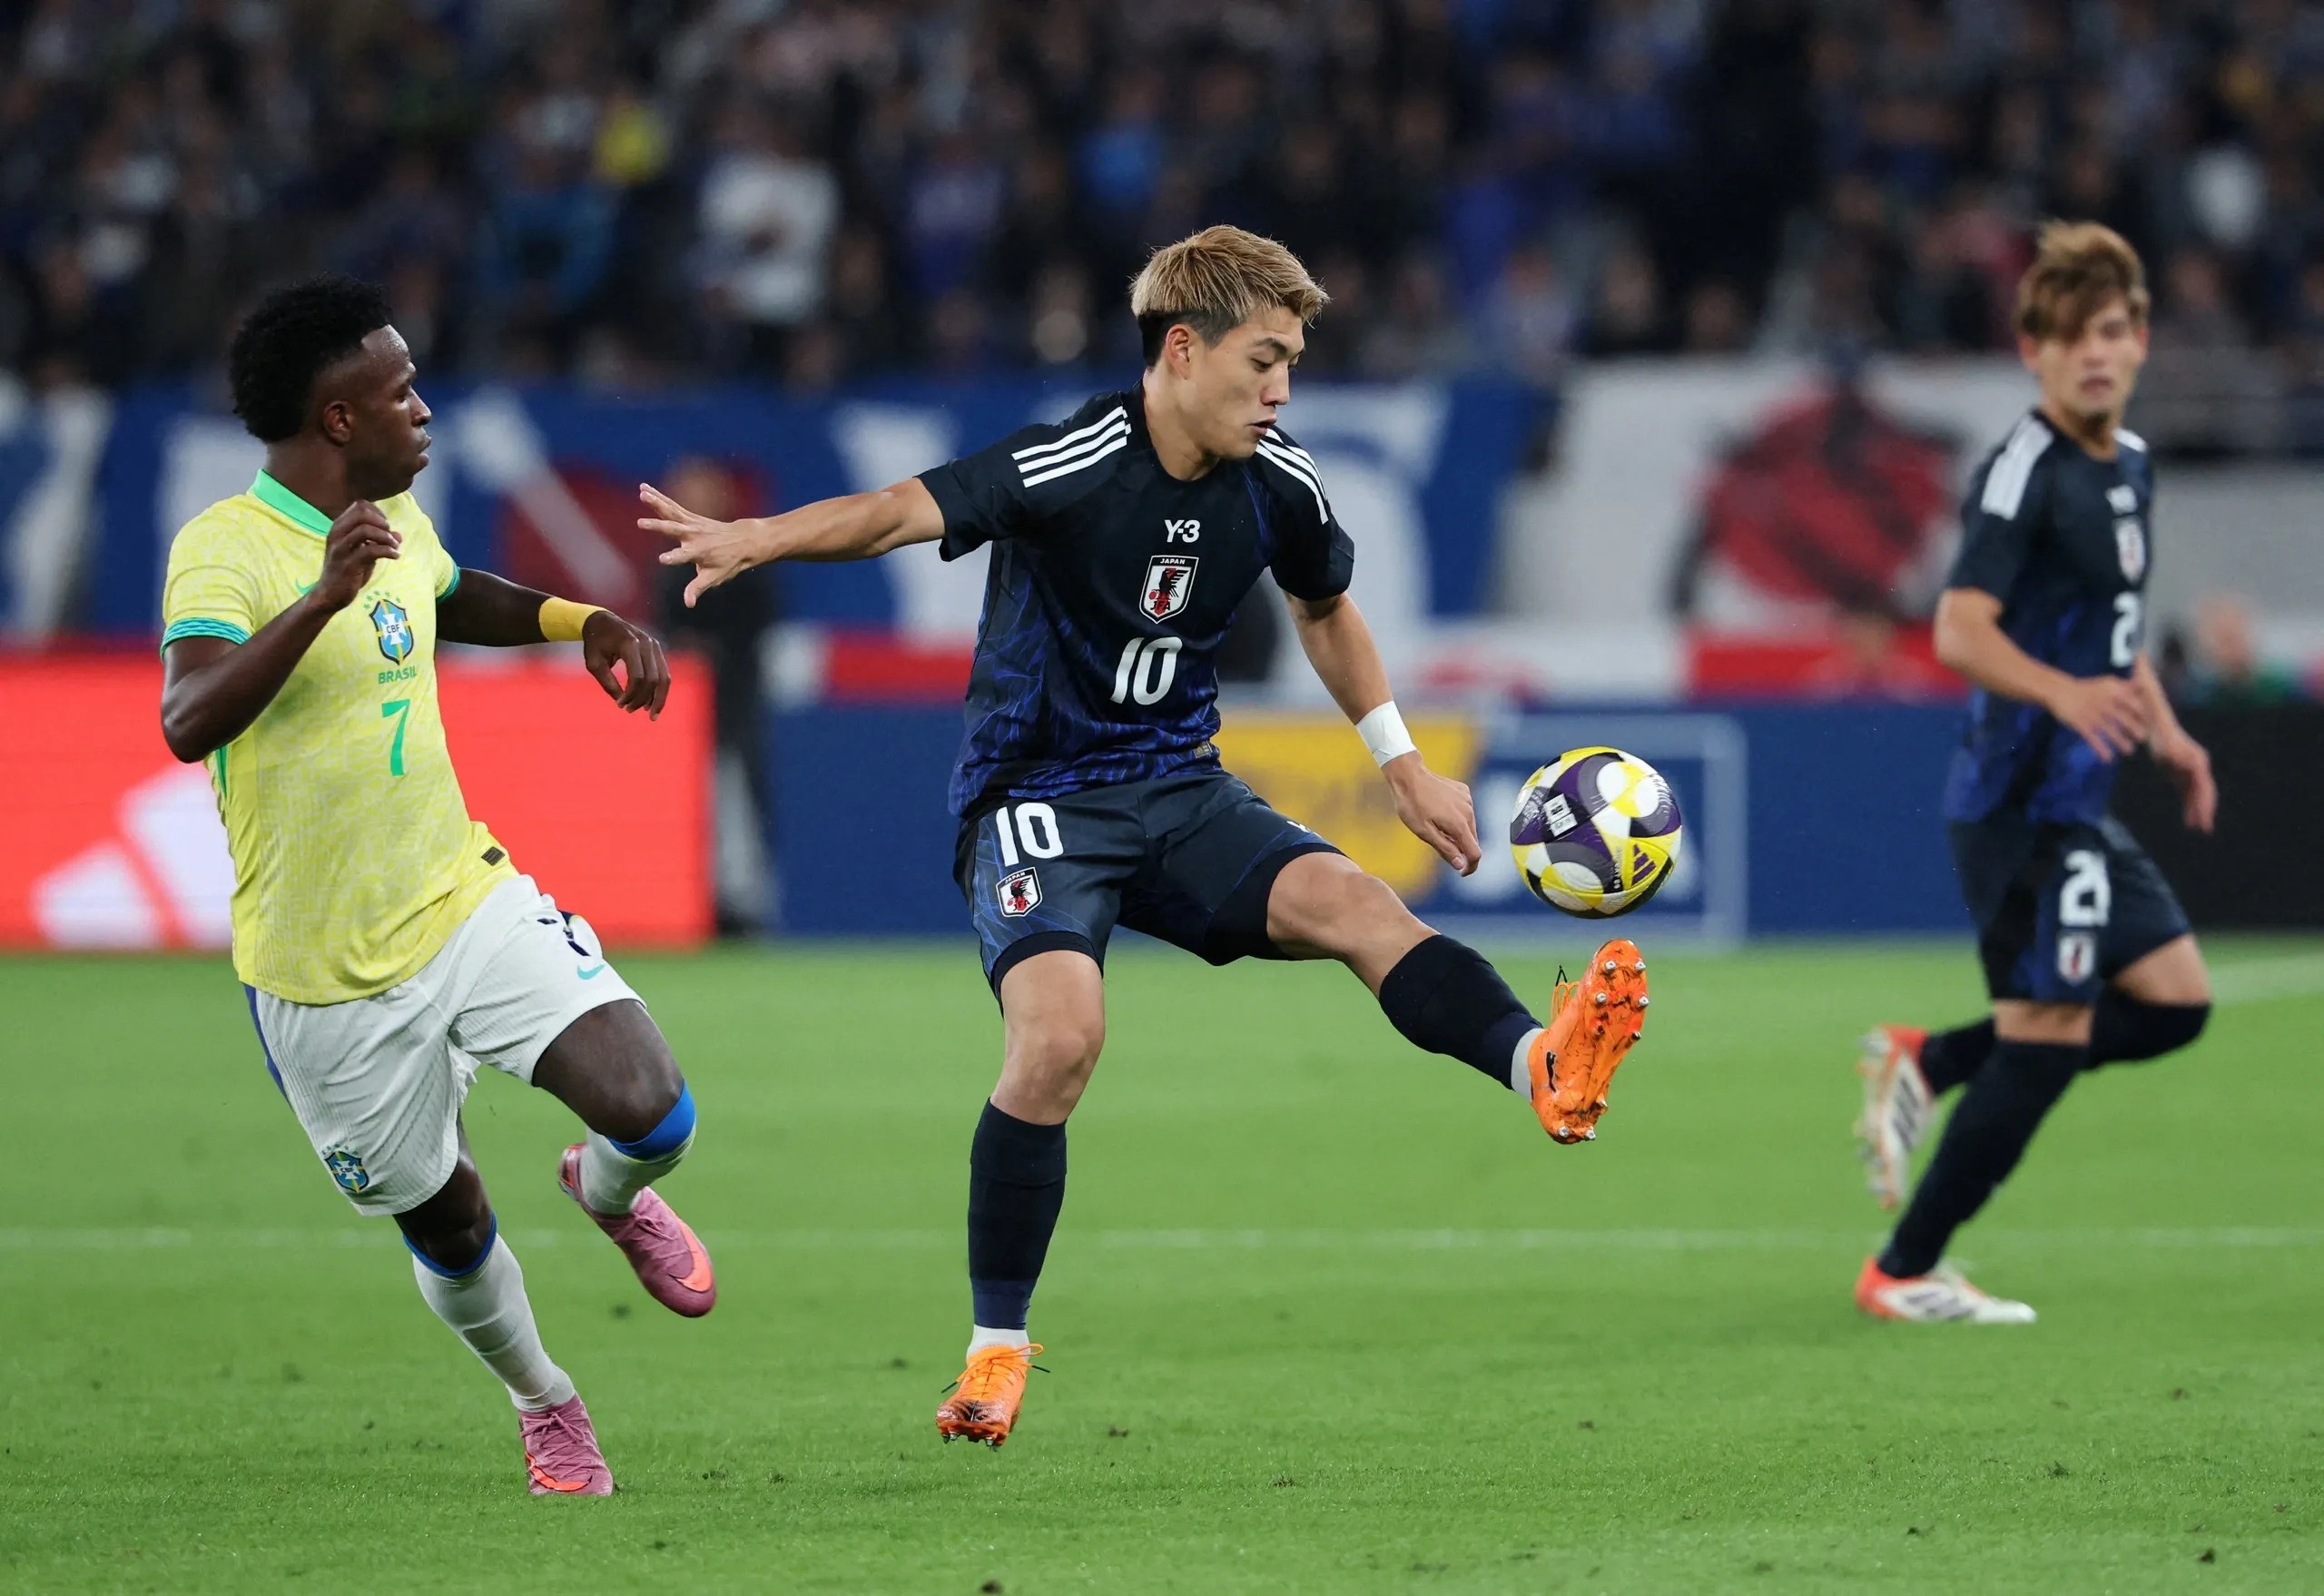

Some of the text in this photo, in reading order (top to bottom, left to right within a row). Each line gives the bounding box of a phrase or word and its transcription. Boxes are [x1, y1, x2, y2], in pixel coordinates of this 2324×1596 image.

[1164, 519, 1201, 543] Y-3
[387, 624, 400, 634] CBF
[378, 665, 417, 684] BRASIL
[1109, 636, 1183, 705] 10
[381, 698, 411, 777] 7
[996, 802, 1064, 867] 10
[1005, 872, 1025, 883] JAPAN
